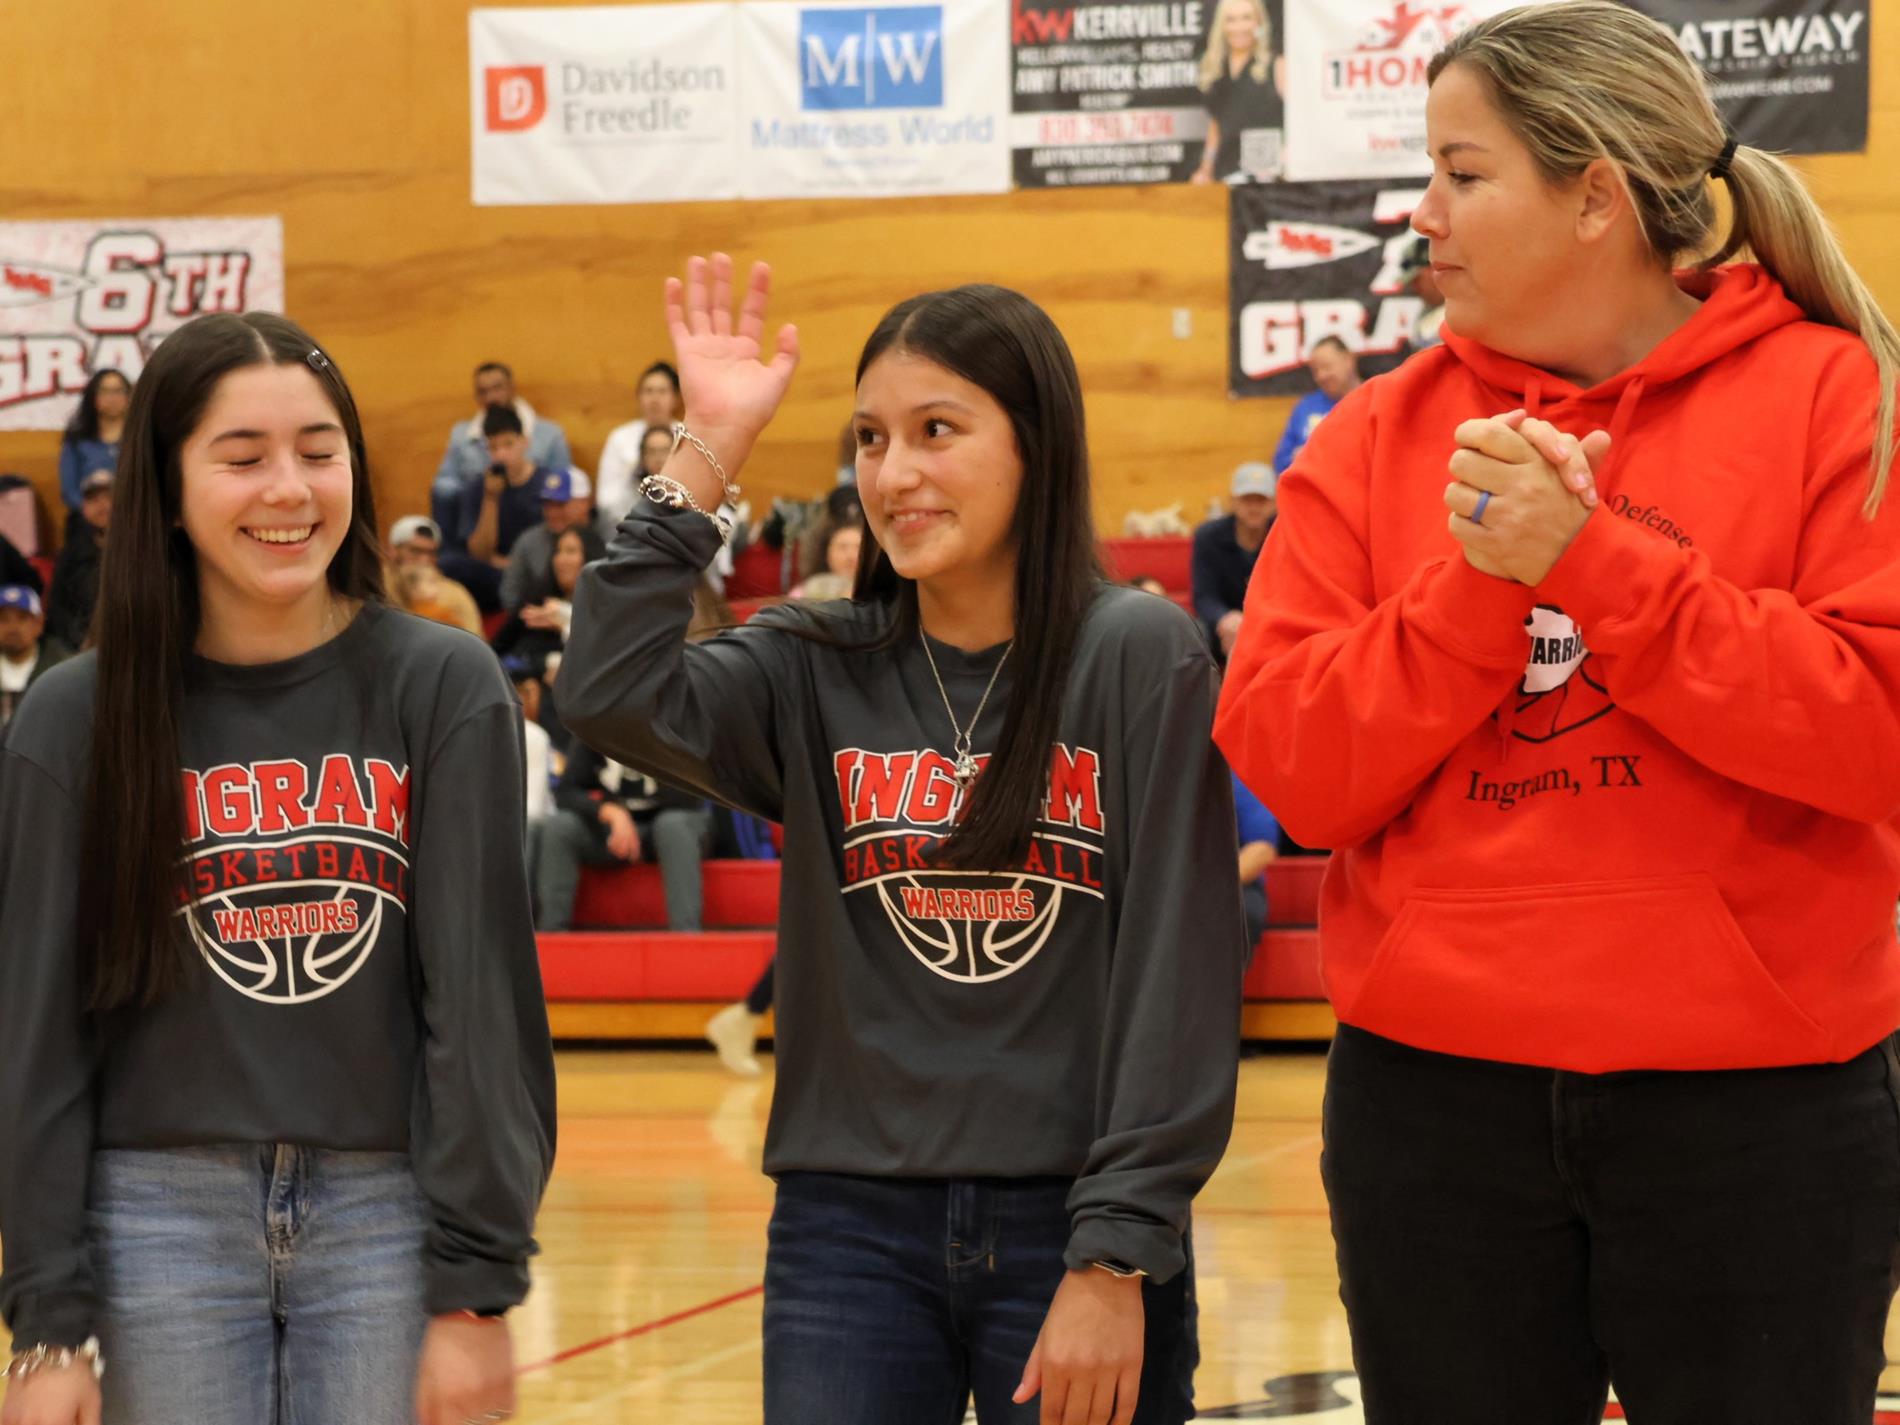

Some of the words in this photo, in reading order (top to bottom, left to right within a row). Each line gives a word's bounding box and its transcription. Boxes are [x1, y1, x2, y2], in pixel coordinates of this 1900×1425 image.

[1677, 11, 1865, 61] ATEWAY
[561, 59, 726, 97] Davidson
[1138, 60, 1200, 90] SMITH
[562, 97, 692, 135] Freedle
[751, 116, 889, 150] Mattress
[899, 113, 994, 145] World
[1528, 633, 1584, 665] ARRI
[833, 741, 1106, 837] INGM
[1465, 764, 1581, 811] Ingram,
[1591, 754, 1644, 788] TX
[177, 842, 408, 904] SKETBALL
[844, 834, 1103, 889] BASKALL
[212, 898, 359, 944] WARRIORS
[899, 886, 1036, 922] WARRIORS
